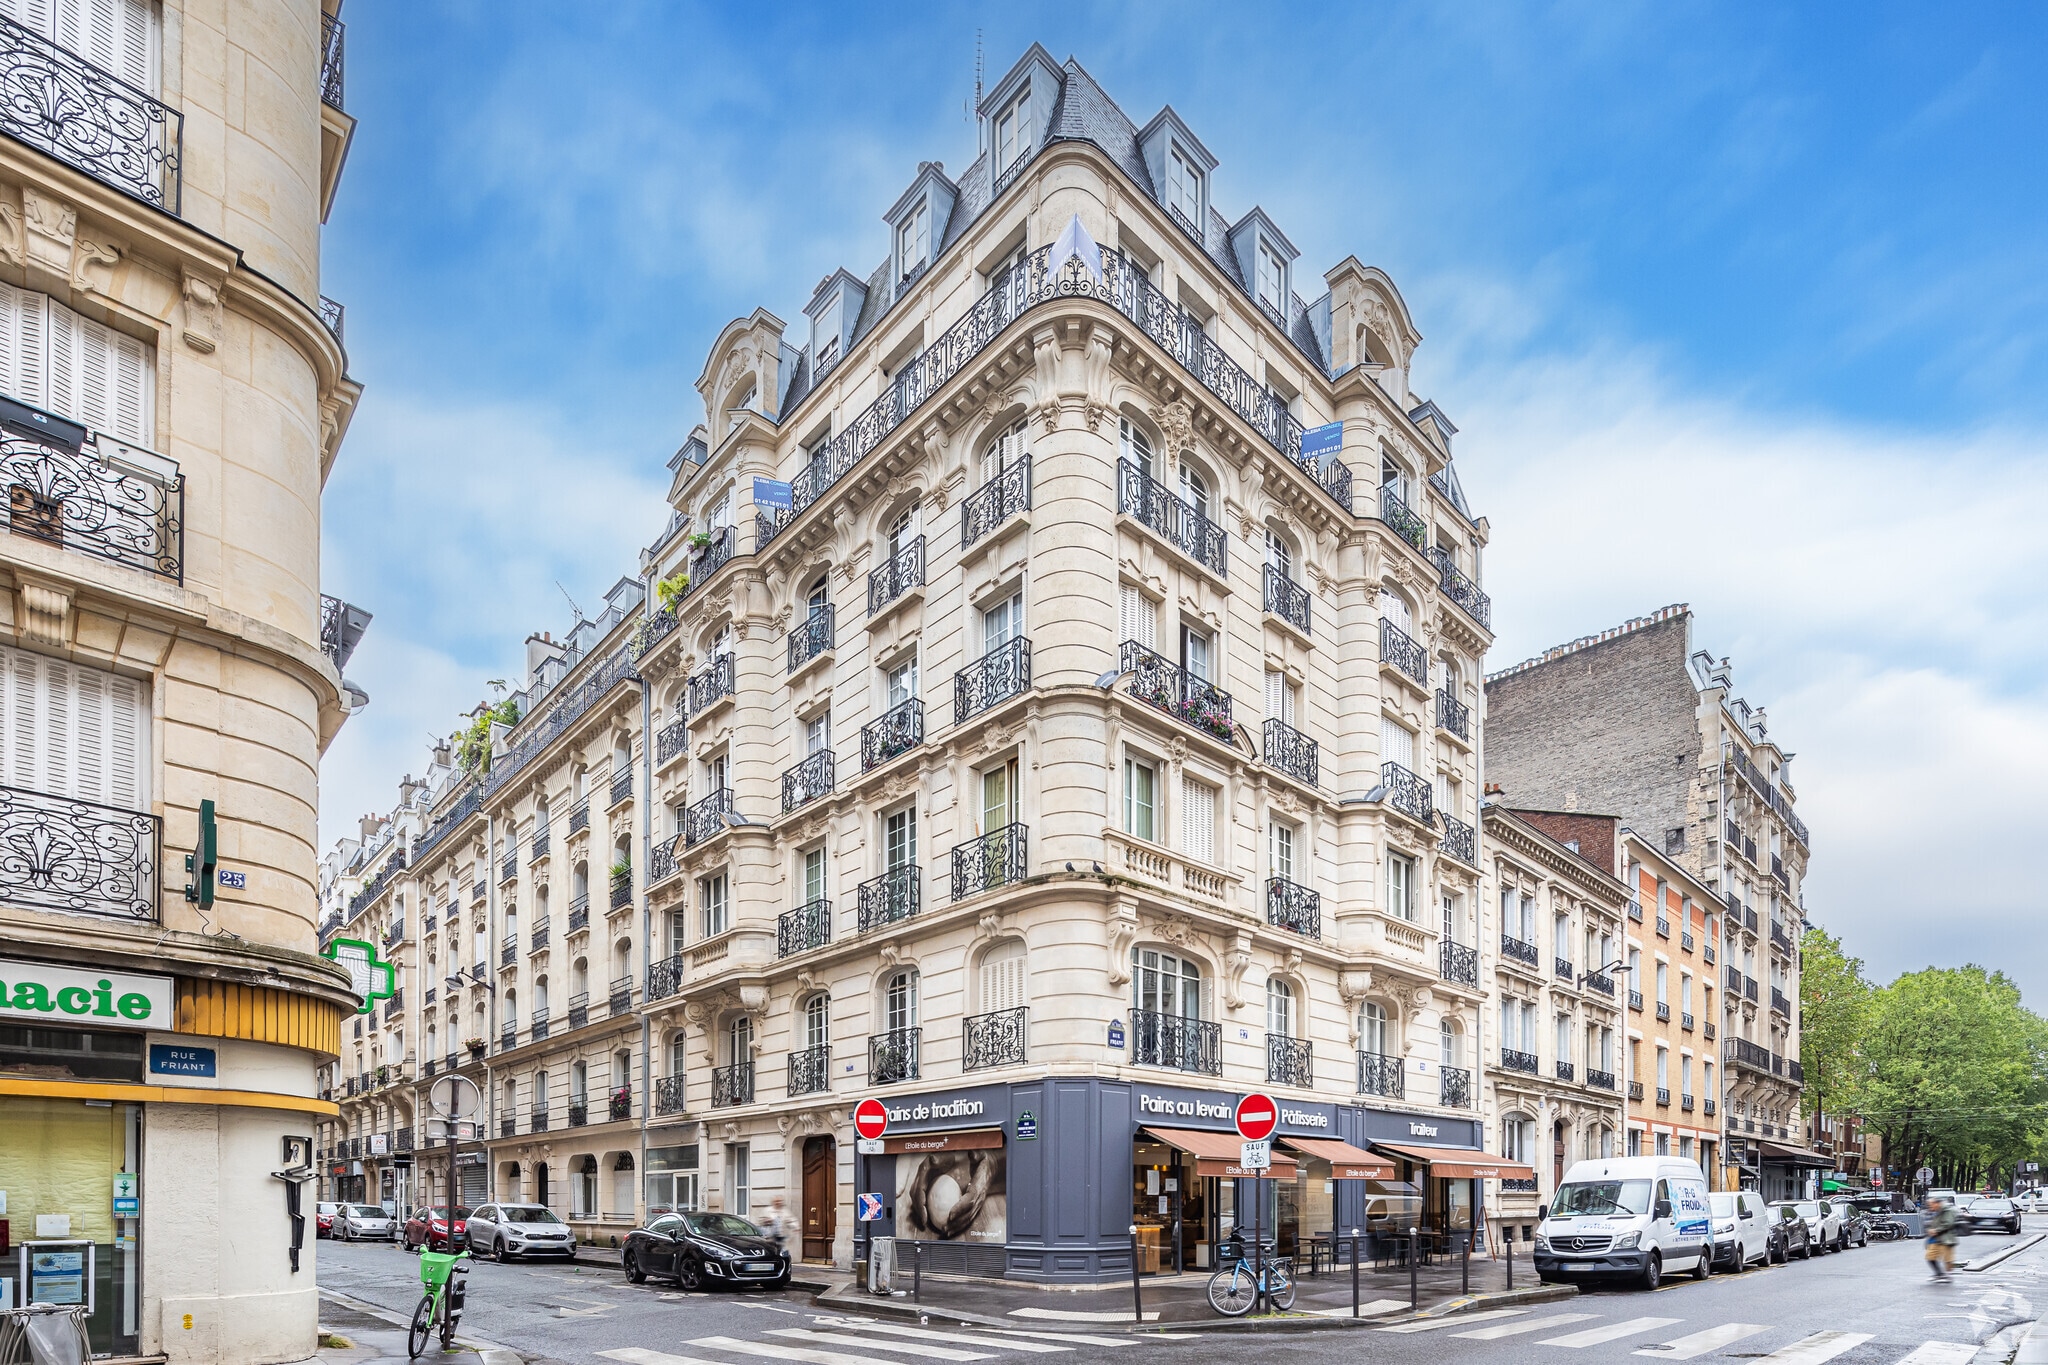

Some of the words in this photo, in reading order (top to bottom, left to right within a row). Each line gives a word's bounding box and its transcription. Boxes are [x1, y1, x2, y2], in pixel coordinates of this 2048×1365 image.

[222, 871, 243, 887] 25
[0, 978, 152, 1020] acie
[171, 1051, 196, 1060] RUE
[161, 1061, 205, 1071] FRIANT
[913, 1104, 929, 1120] de
[931, 1099, 983, 1118] tradition
[1140, 1094, 1174, 1114] Pains
[1176, 1101, 1194, 1116] au
[1196, 1099, 1232, 1119] levain
[1281, 1108, 1328, 1127] Pâtisserie
[1409, 1121, 1438, 1137] Traiteur
[920, 1141, 927, 1149] du
[1246, 1142, 1265, 1151] SAUF
[1250, 1168, 1268, 1177] beger
